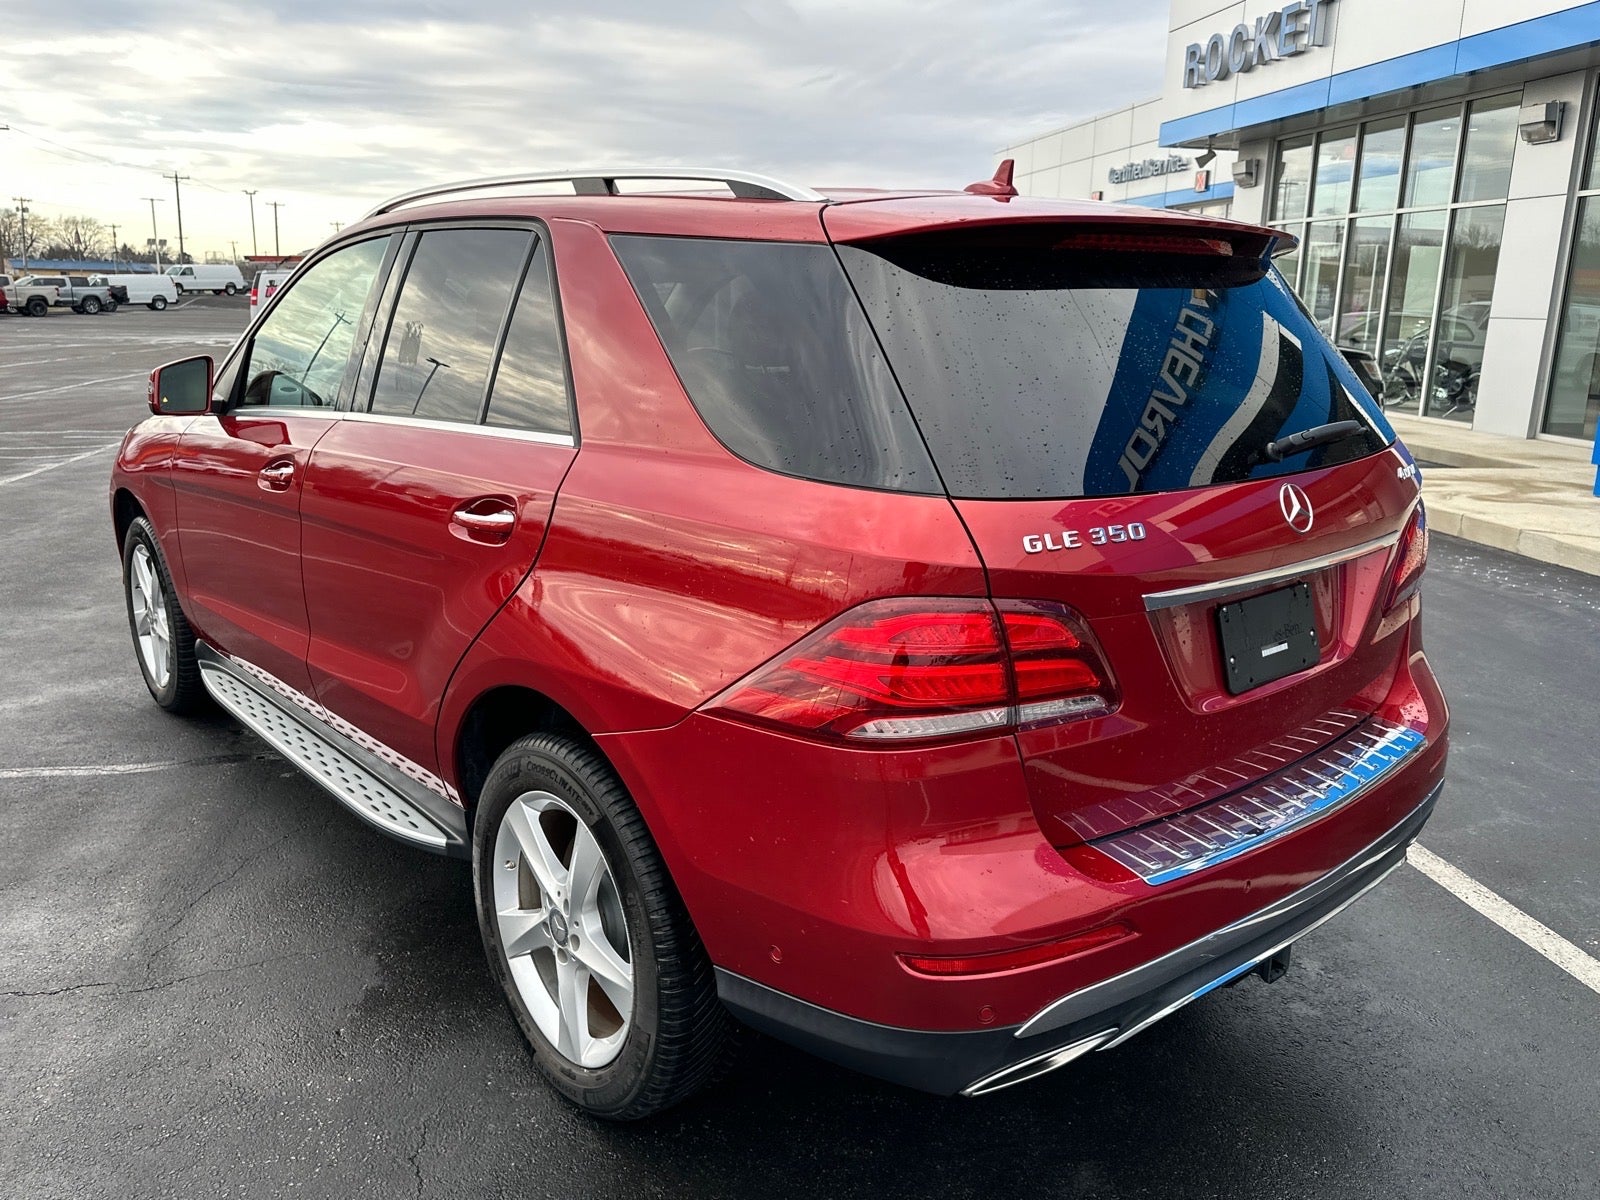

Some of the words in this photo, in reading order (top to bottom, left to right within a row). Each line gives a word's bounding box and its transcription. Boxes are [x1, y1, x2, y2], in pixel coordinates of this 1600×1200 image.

[1183, 0, 1326, 88] ROCKET
[1109, 161, 1149, 184] Certified
[1148, 154, 1186, 178] Service
[1022, 530, 1083, 554] GLE
[1088, 522, 1146, 545] 350
